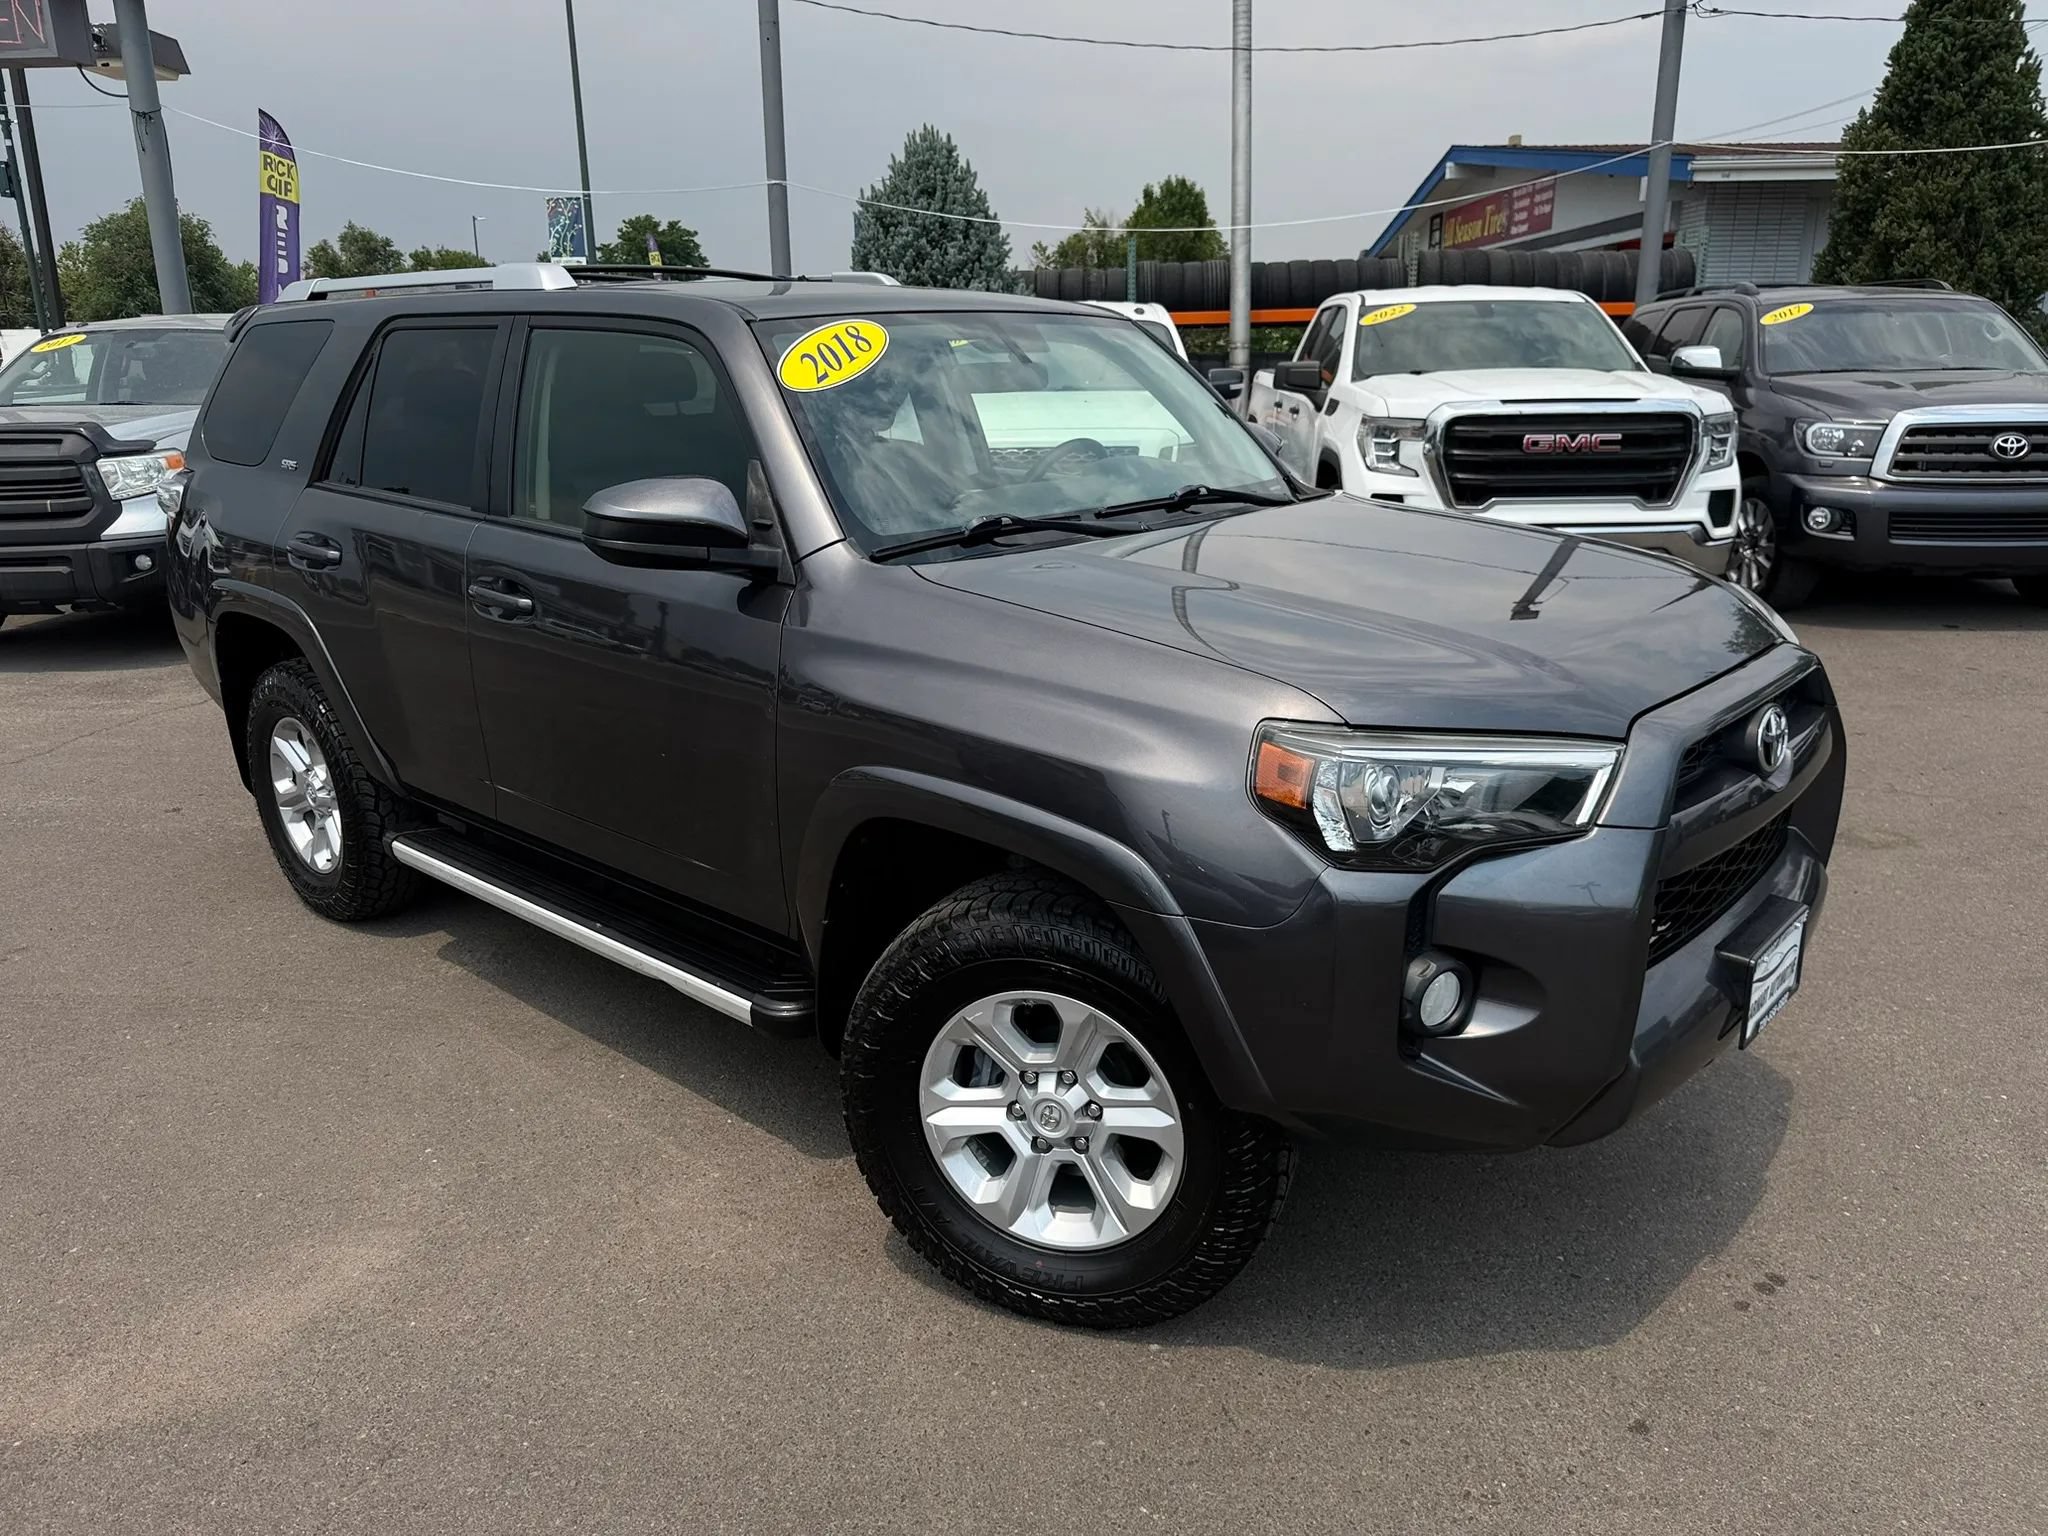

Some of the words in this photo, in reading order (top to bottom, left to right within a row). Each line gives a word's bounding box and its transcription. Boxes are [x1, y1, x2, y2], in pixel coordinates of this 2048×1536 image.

[1455, 215, 1482, 244] Season
[1371, 305, 1406, 323] 2022
[1772, 304, 1801, 322] 2017
[800, 325, 872, 384] 2018
[1523, 433, 1622, 453] GMC
